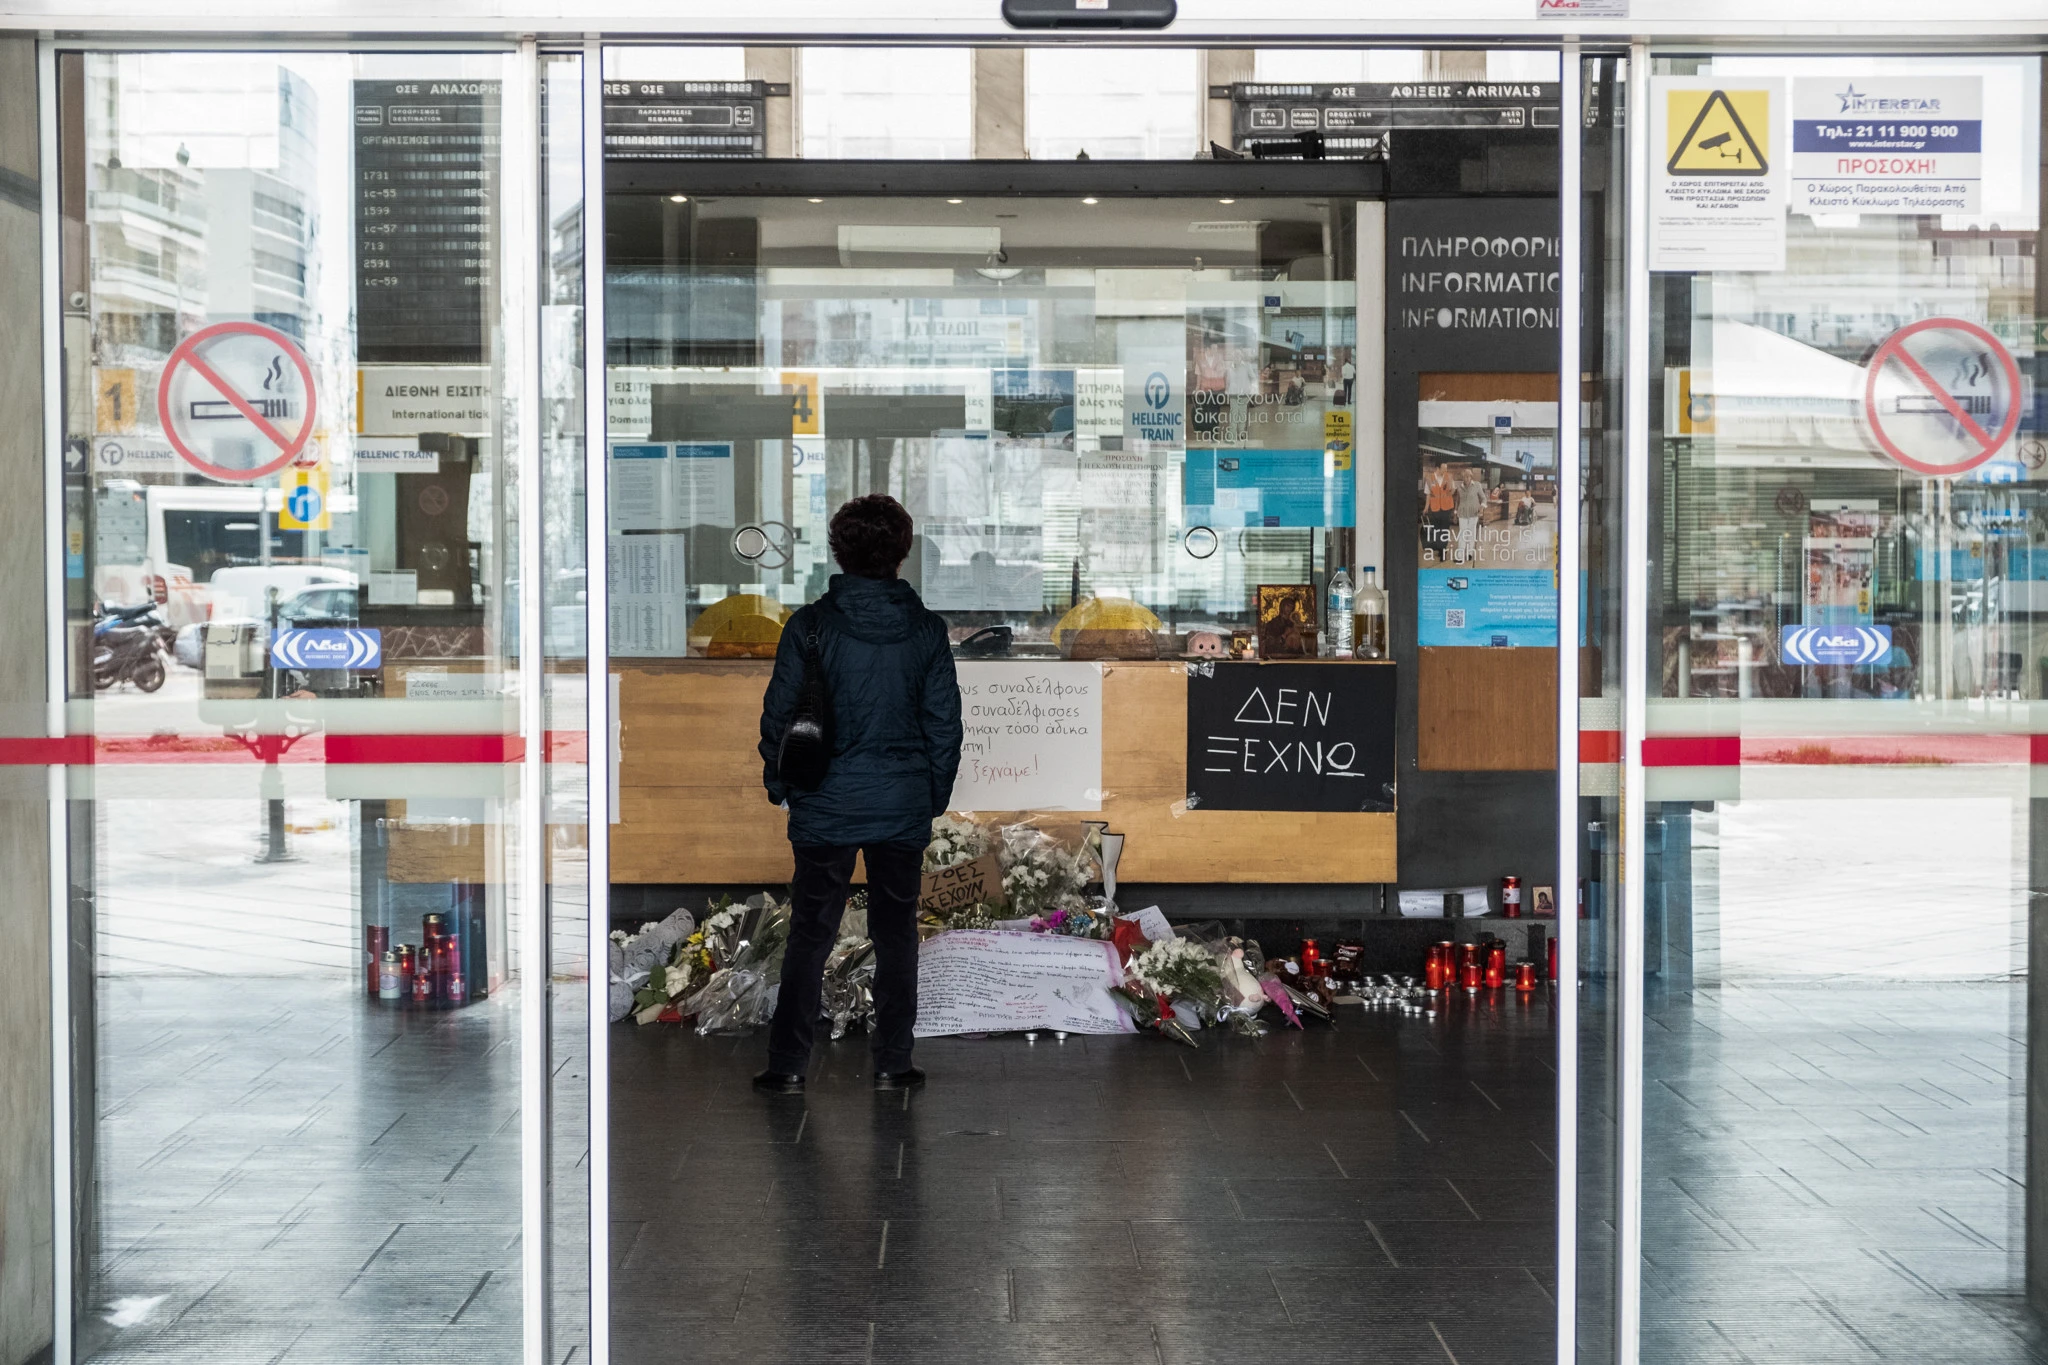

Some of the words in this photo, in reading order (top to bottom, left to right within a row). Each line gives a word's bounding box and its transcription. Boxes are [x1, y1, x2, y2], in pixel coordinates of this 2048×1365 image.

[395, 84, 419, 94] ΟΣΕ
[640, 84, 664, 94] ΟΣΕ
[1333, 87, 1356, 97] ΟΣΕ
[1390, 85, 1451, 97] ΑΦΙΞΕΙΣ
[1466, 85, 1541, 97] ARRIVALS
[1852, 98, 1941, 110] INTERSTAR
[1816, 125, 1853, 139] Τηλ.:
[1856, 125, 1873, 137] 21
[1878, 125, 1895, 137] 11
[1900, 125, 1927, 137] 900
[1931, 125, 1958, 137] 900
[1849, 140, 1926, 149] www.interstar.gr
[1838, 158, 1937, 174] ΠΡΟΣΟΧΗ!
[1819, 183, 1853, 194] Χώρος
[1856, 183, 1941, 194] Παρακολουθείται
[1944, 183, 1966, 194] Από
[1809, 196, 1849, 206] Κλειστό
[1852, 196, 1900, 208] Κύκλωμα
[1903, 196, 1965, 208] Τηλεόρασης
[1402, 272, 1561, 293] INFORMATIO
[385, 386, 439, 397] ΔΙΕΘΝΗ
[1192, 389, 1230, 405] Όλοι
[105, 382, 121, 420] 1
[792, 385, 813, 423] 4
[392, 409, 465, 419] International
[1132, 413, 1182, 425] HELLENIC
[1332, 414, 1344, 423] Τα
[1141, 428, 1174, 440] TRAIN
[1194, 426, 1249, 445] ταξίδια
[127, 450, 174, 459] HELLENIC
[354, 450, 399, 459] HELLENIC
[403, 450, 434, 459] TRAIN
[1423, 524, 1511, 546] Travelling
[1520, 525, 1531, 542] is
[1423, 547, 1434, 561] a
[1442, 544, 1486, 565] right
[1493, 544, 1518, 561] for
[1525, 544, 1547, 562] all
[988, 676, 1088, 700] συναδέλφους
[970, 697, 1080, 723] συναδέλφισσες
[1235, 687, 1332, 727] ΔΕΝ
[1006, 722, 1039, 735] τόσο
[1046, 719, 1088, 735] άδικα
[1205, 736, 1365, 776] ΞΕΧΝΩ
[971, 754, 1038, 784] ξεχνάμε!
[929, 861, 985, 892] ΖΩΕΣ
